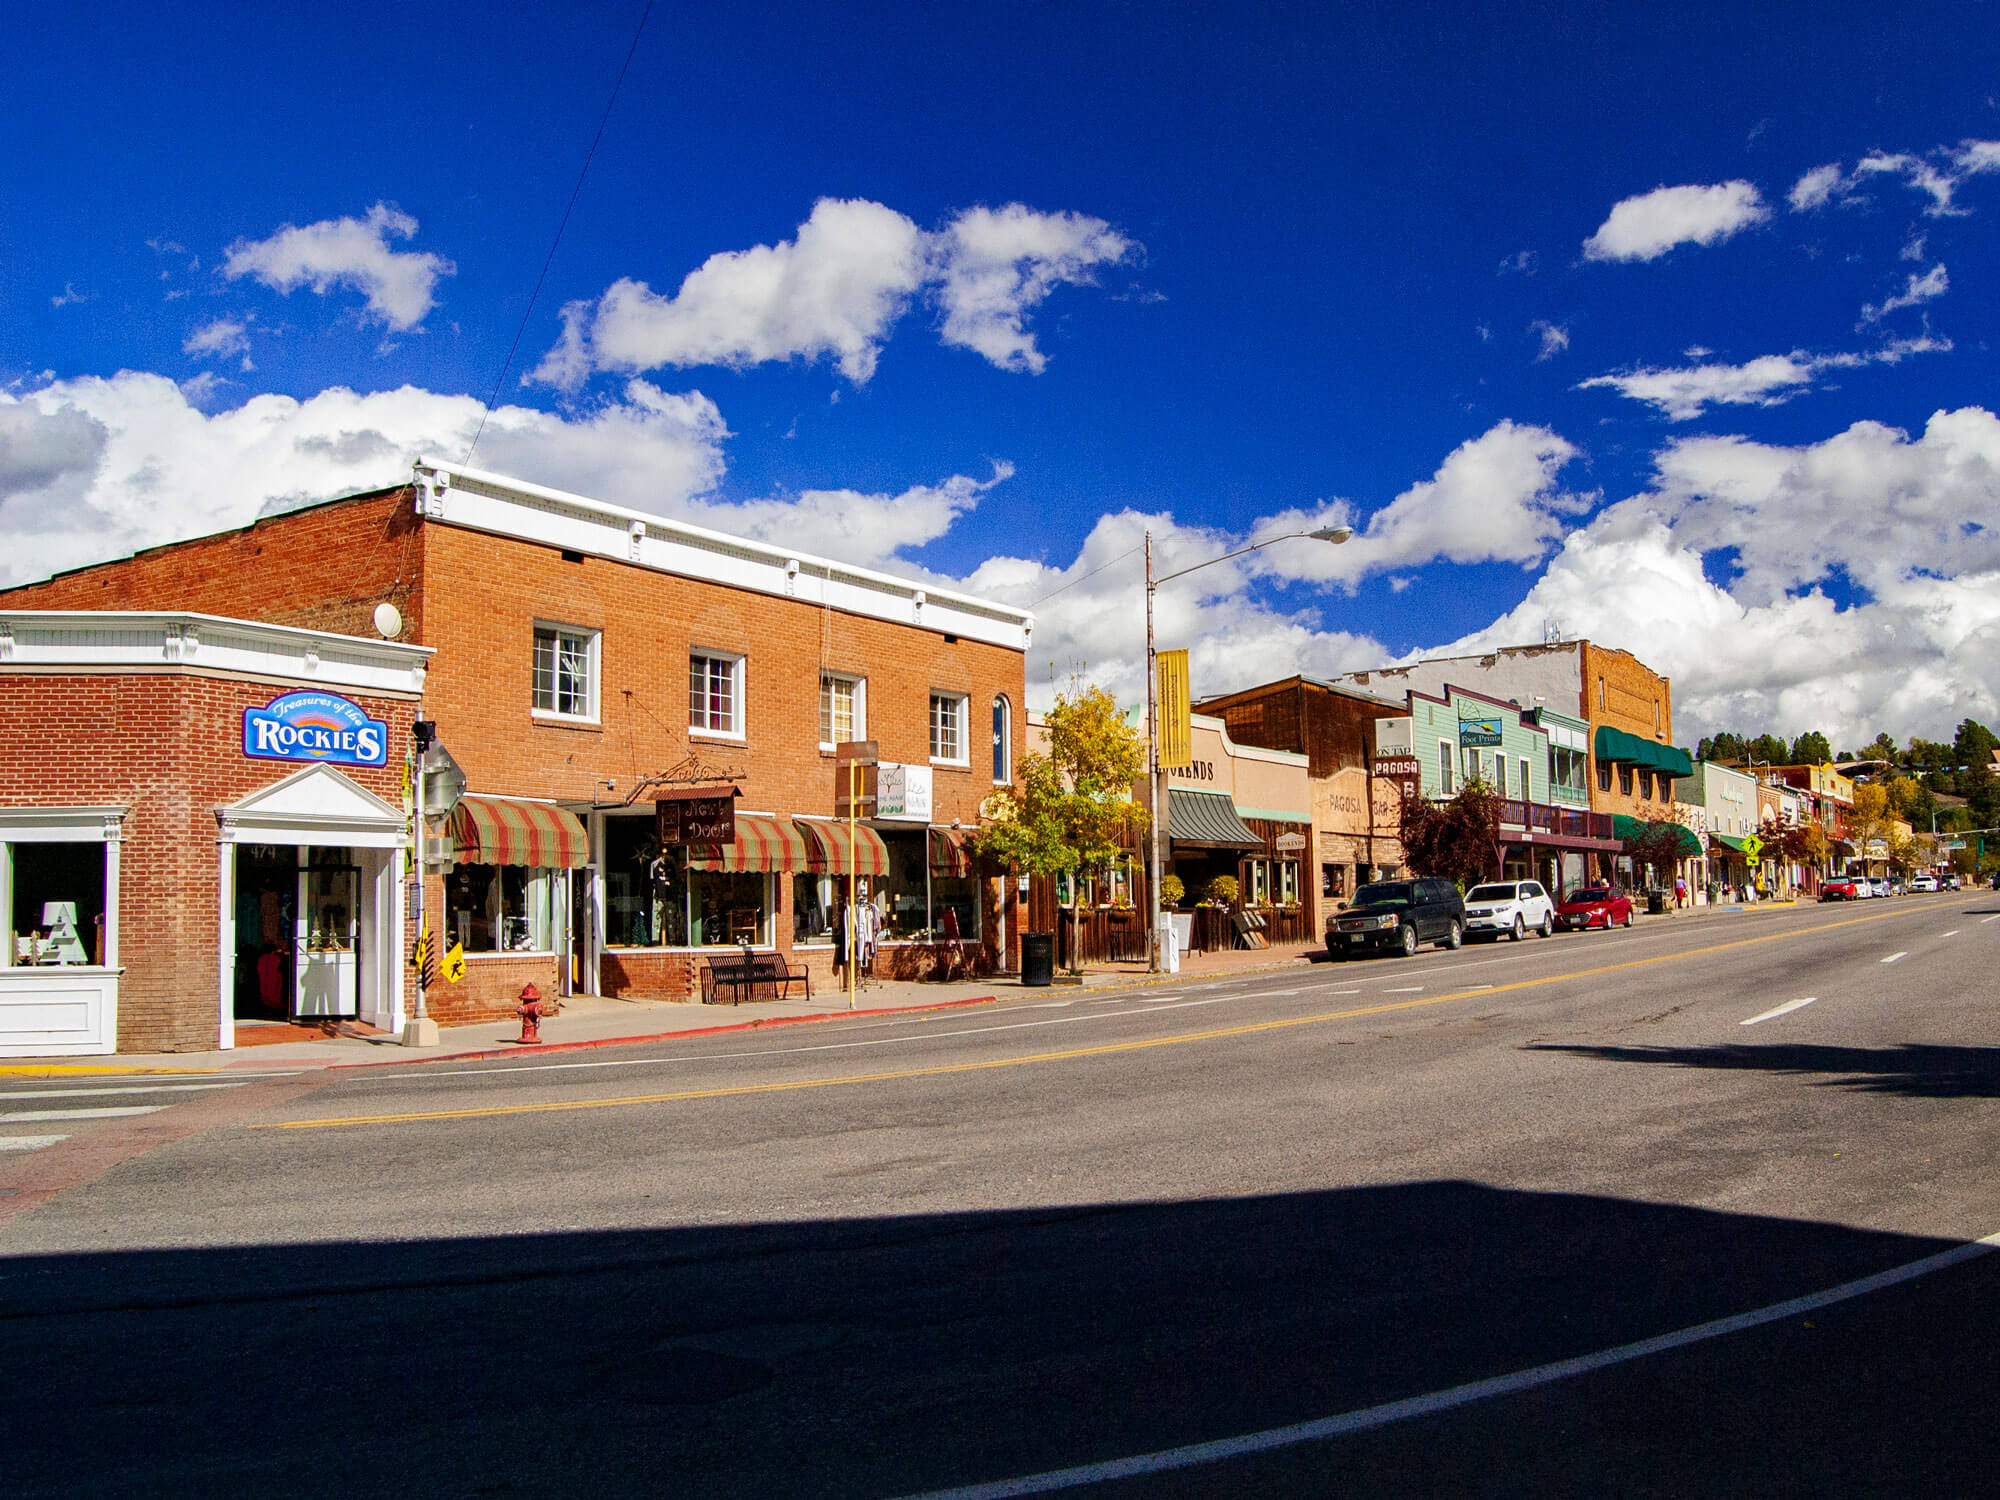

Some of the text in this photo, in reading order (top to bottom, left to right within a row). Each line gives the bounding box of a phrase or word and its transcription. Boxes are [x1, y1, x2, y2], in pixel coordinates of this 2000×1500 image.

[272, 697, 363, 726] Treasures of the
[253, 717, 381, 761] ROCKIES
[1375, 761, 1418, 774] PAGOSA
[685, 799, 725, 816] Next
[1329, 794, 1389, 817] PAGOSA BAR
[689, 821, 731, 839] Door
